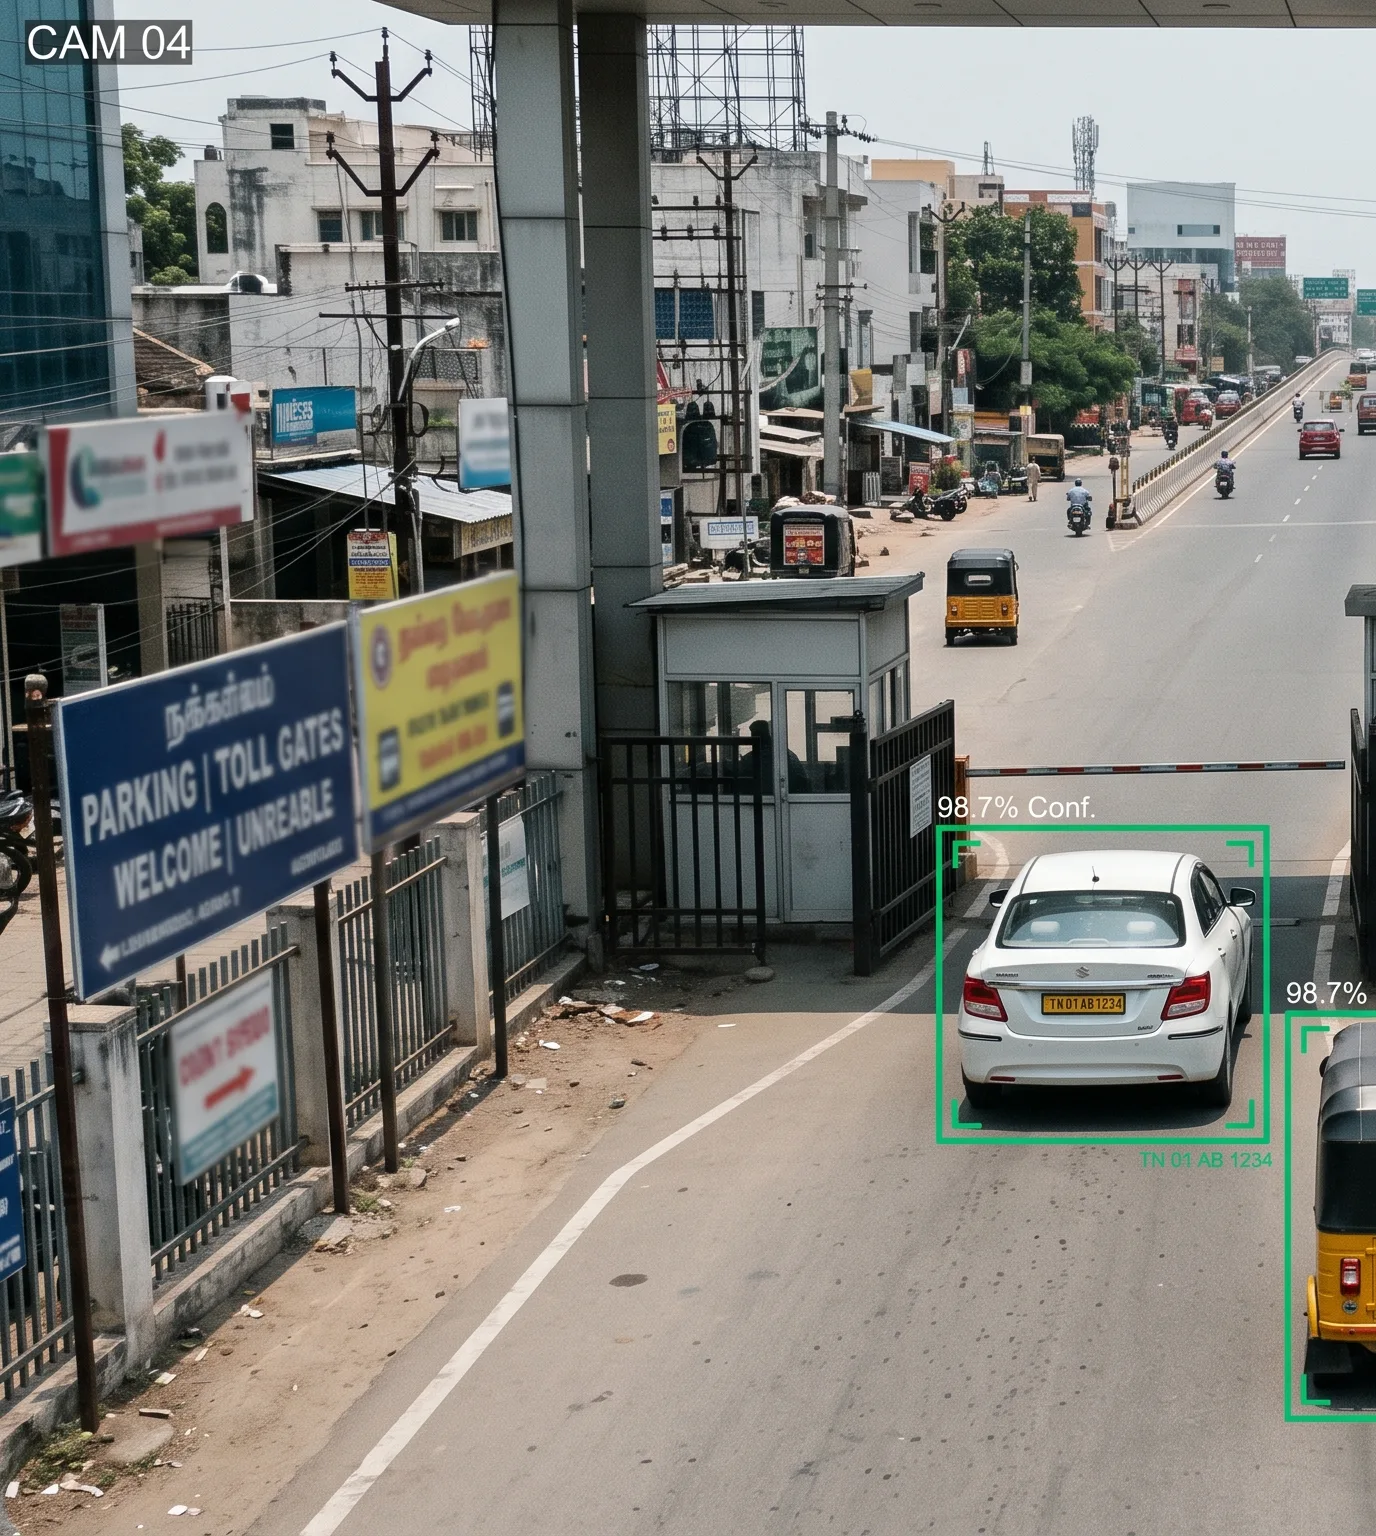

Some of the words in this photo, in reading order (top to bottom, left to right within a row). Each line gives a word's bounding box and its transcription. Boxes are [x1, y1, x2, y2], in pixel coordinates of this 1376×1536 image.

[81, 760, 197, 847] PARKING
[214, 733, 275, 795] TOLL
[277, 707, 344, 772] GATES
[113, 823, 224, 911] WELCOME
[236, 777, 334, 856] UNREABLE
